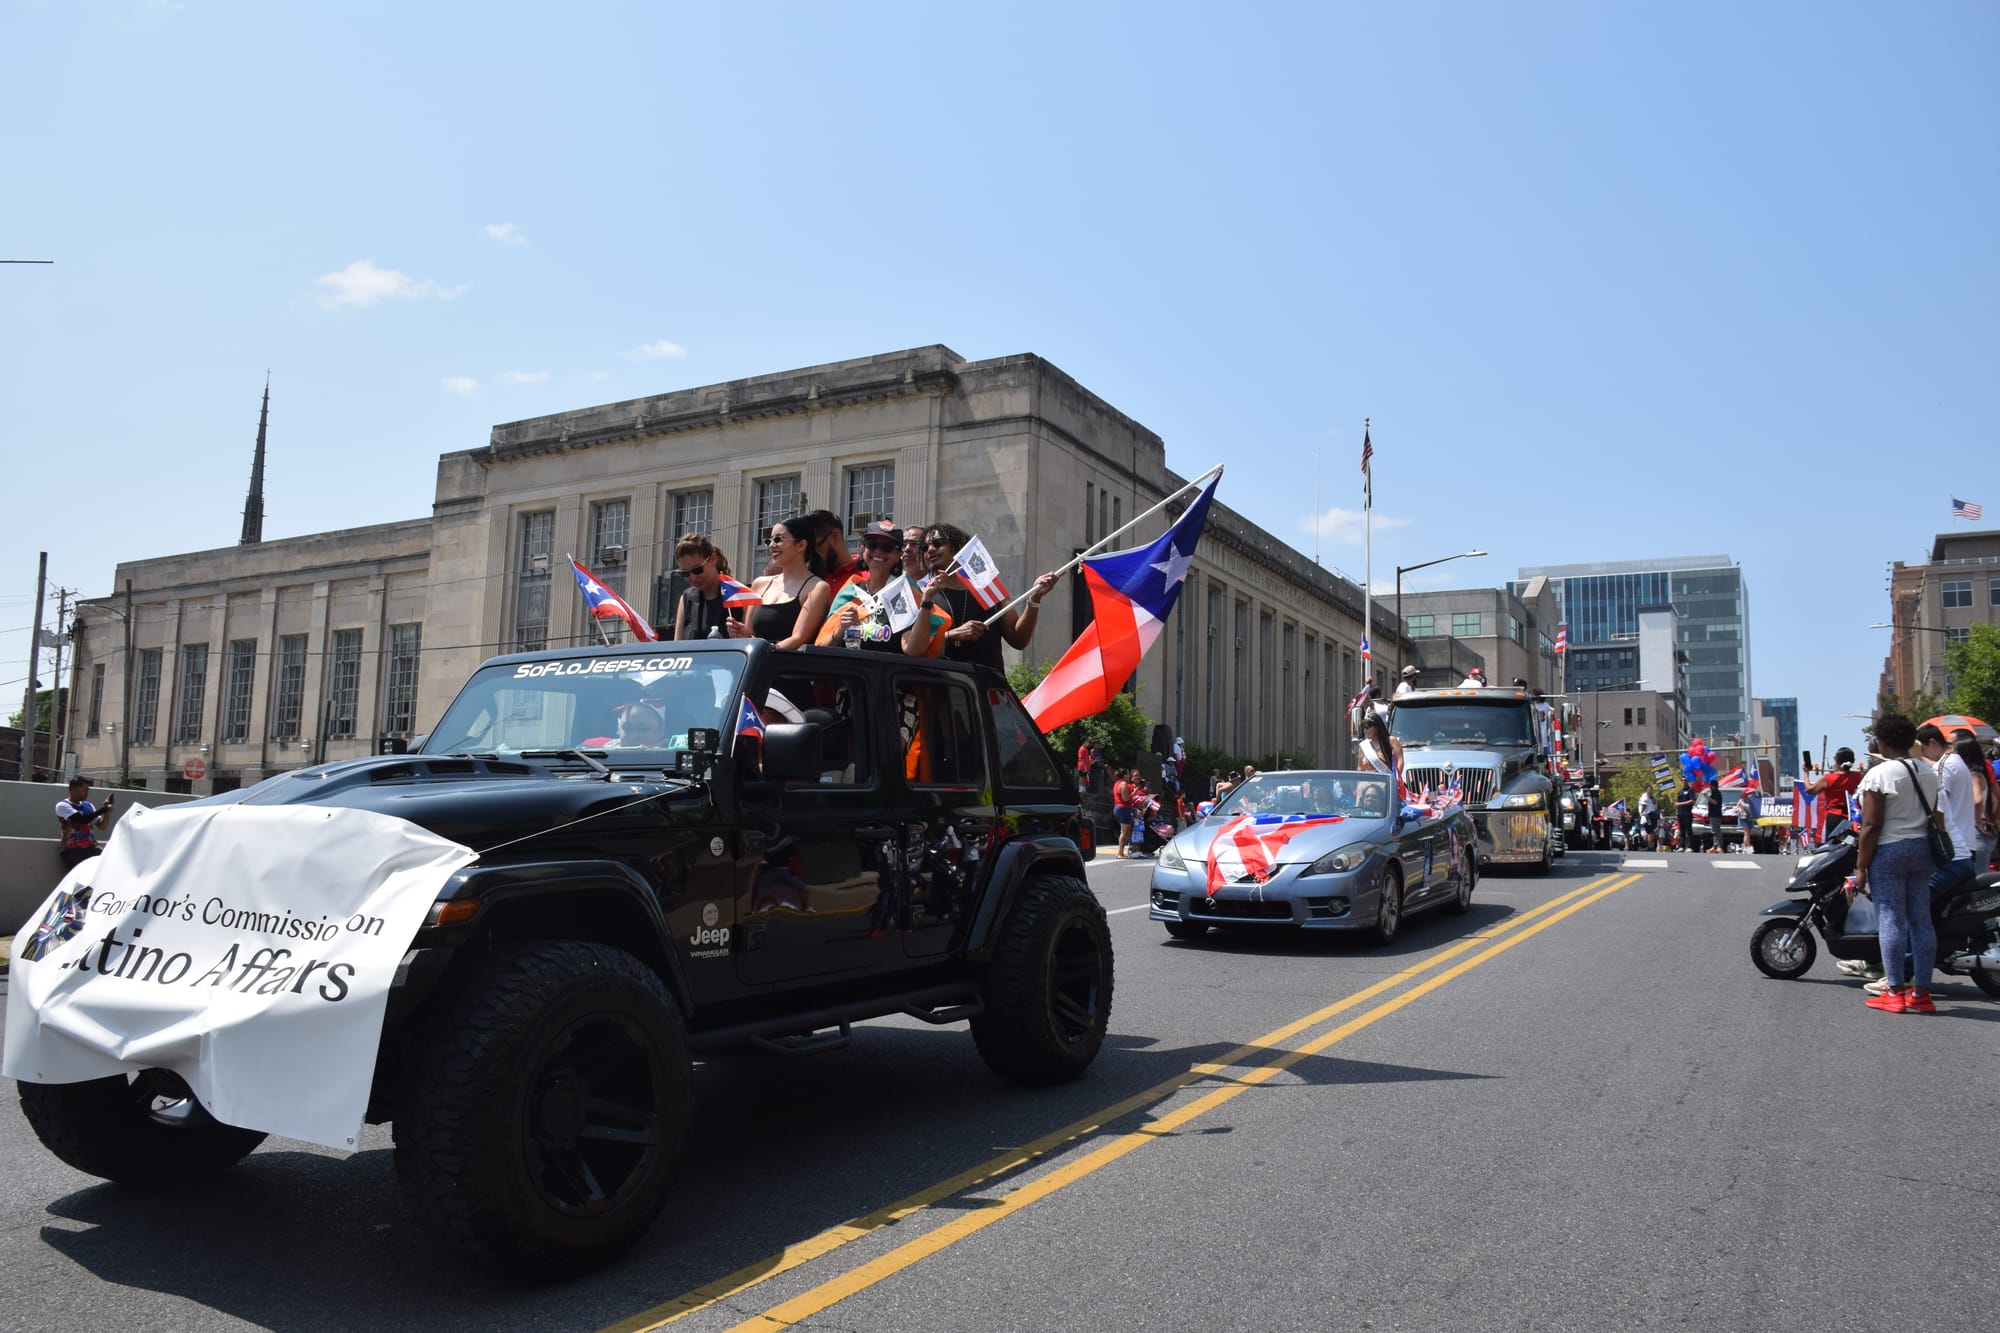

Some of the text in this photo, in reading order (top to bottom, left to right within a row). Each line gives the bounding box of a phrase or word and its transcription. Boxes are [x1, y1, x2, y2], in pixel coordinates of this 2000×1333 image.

[1760, 804, 1793, 817] MACKE
[202, 897, 339, 941] Commissio
[690, 925, 730, 946] Jeep
